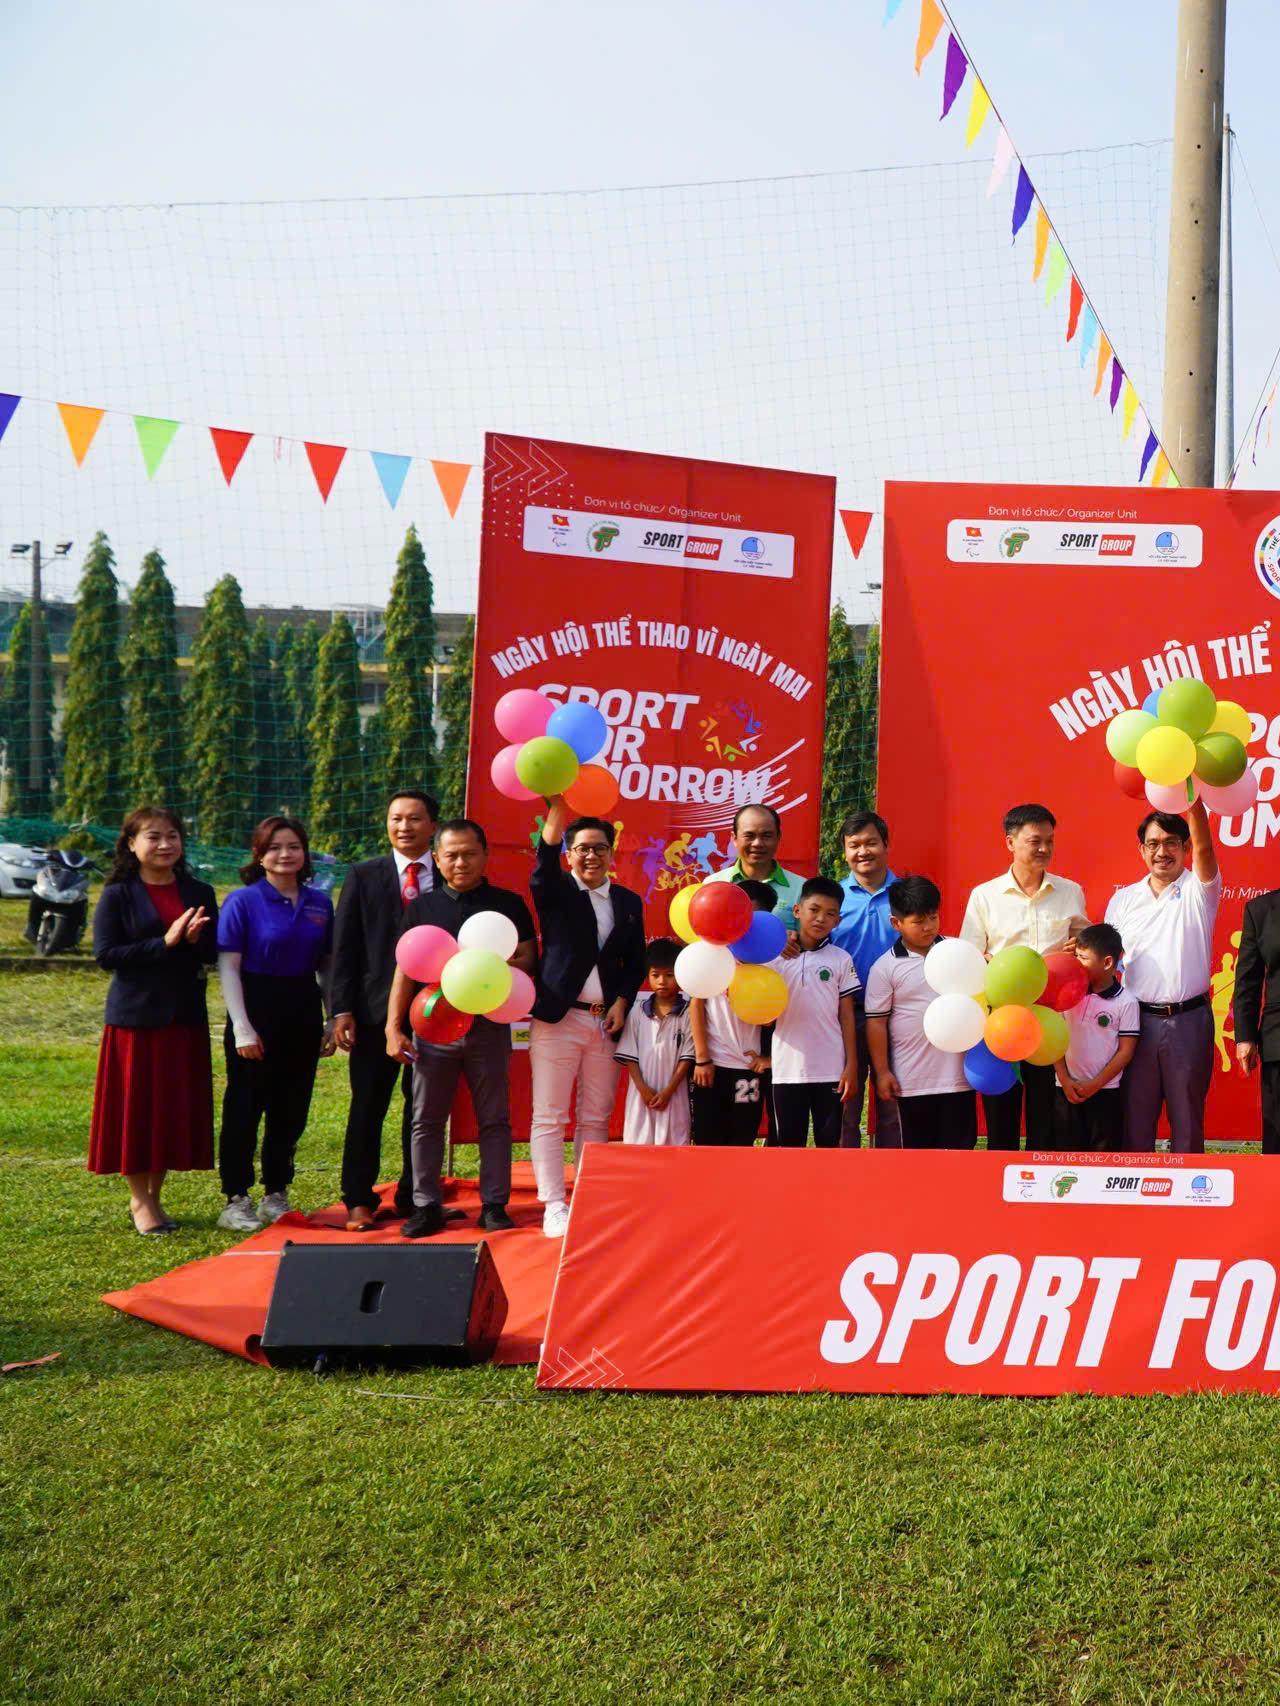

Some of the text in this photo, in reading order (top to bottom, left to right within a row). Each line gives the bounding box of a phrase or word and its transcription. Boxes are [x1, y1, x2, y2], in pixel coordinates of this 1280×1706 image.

[668, 505, 718, 520] Organizer
[720, 511, 742, 523] Unit
[1067, 508, 1115, 519] Organizer
[1117, 509, 1137, 519] Unit
[643, 531, 719, 556] SPORT GROUP
[1060, 533, 1132, 552] SPORT GROUP
[490, 613, 813, 702] NGÀY HỘI THỂ THAO VÌ NGÀY MAI
[1049, 665, 1139, 742] NGÀY
[1207, 620, 1272, 680] THỂ
[606, 761, 771, 806] ORROW
[1220, 886, 1236, 899] hí
[734, 1078, 760, 1104] 23
[1112, 1154, 1161, 1166] Organizer
[1163, 1156, 1184, 1165] Unit
[1105, 1177, 1171, 1193] SPORT GROUP
[819, 1252, 1141, 1367] SPORT
